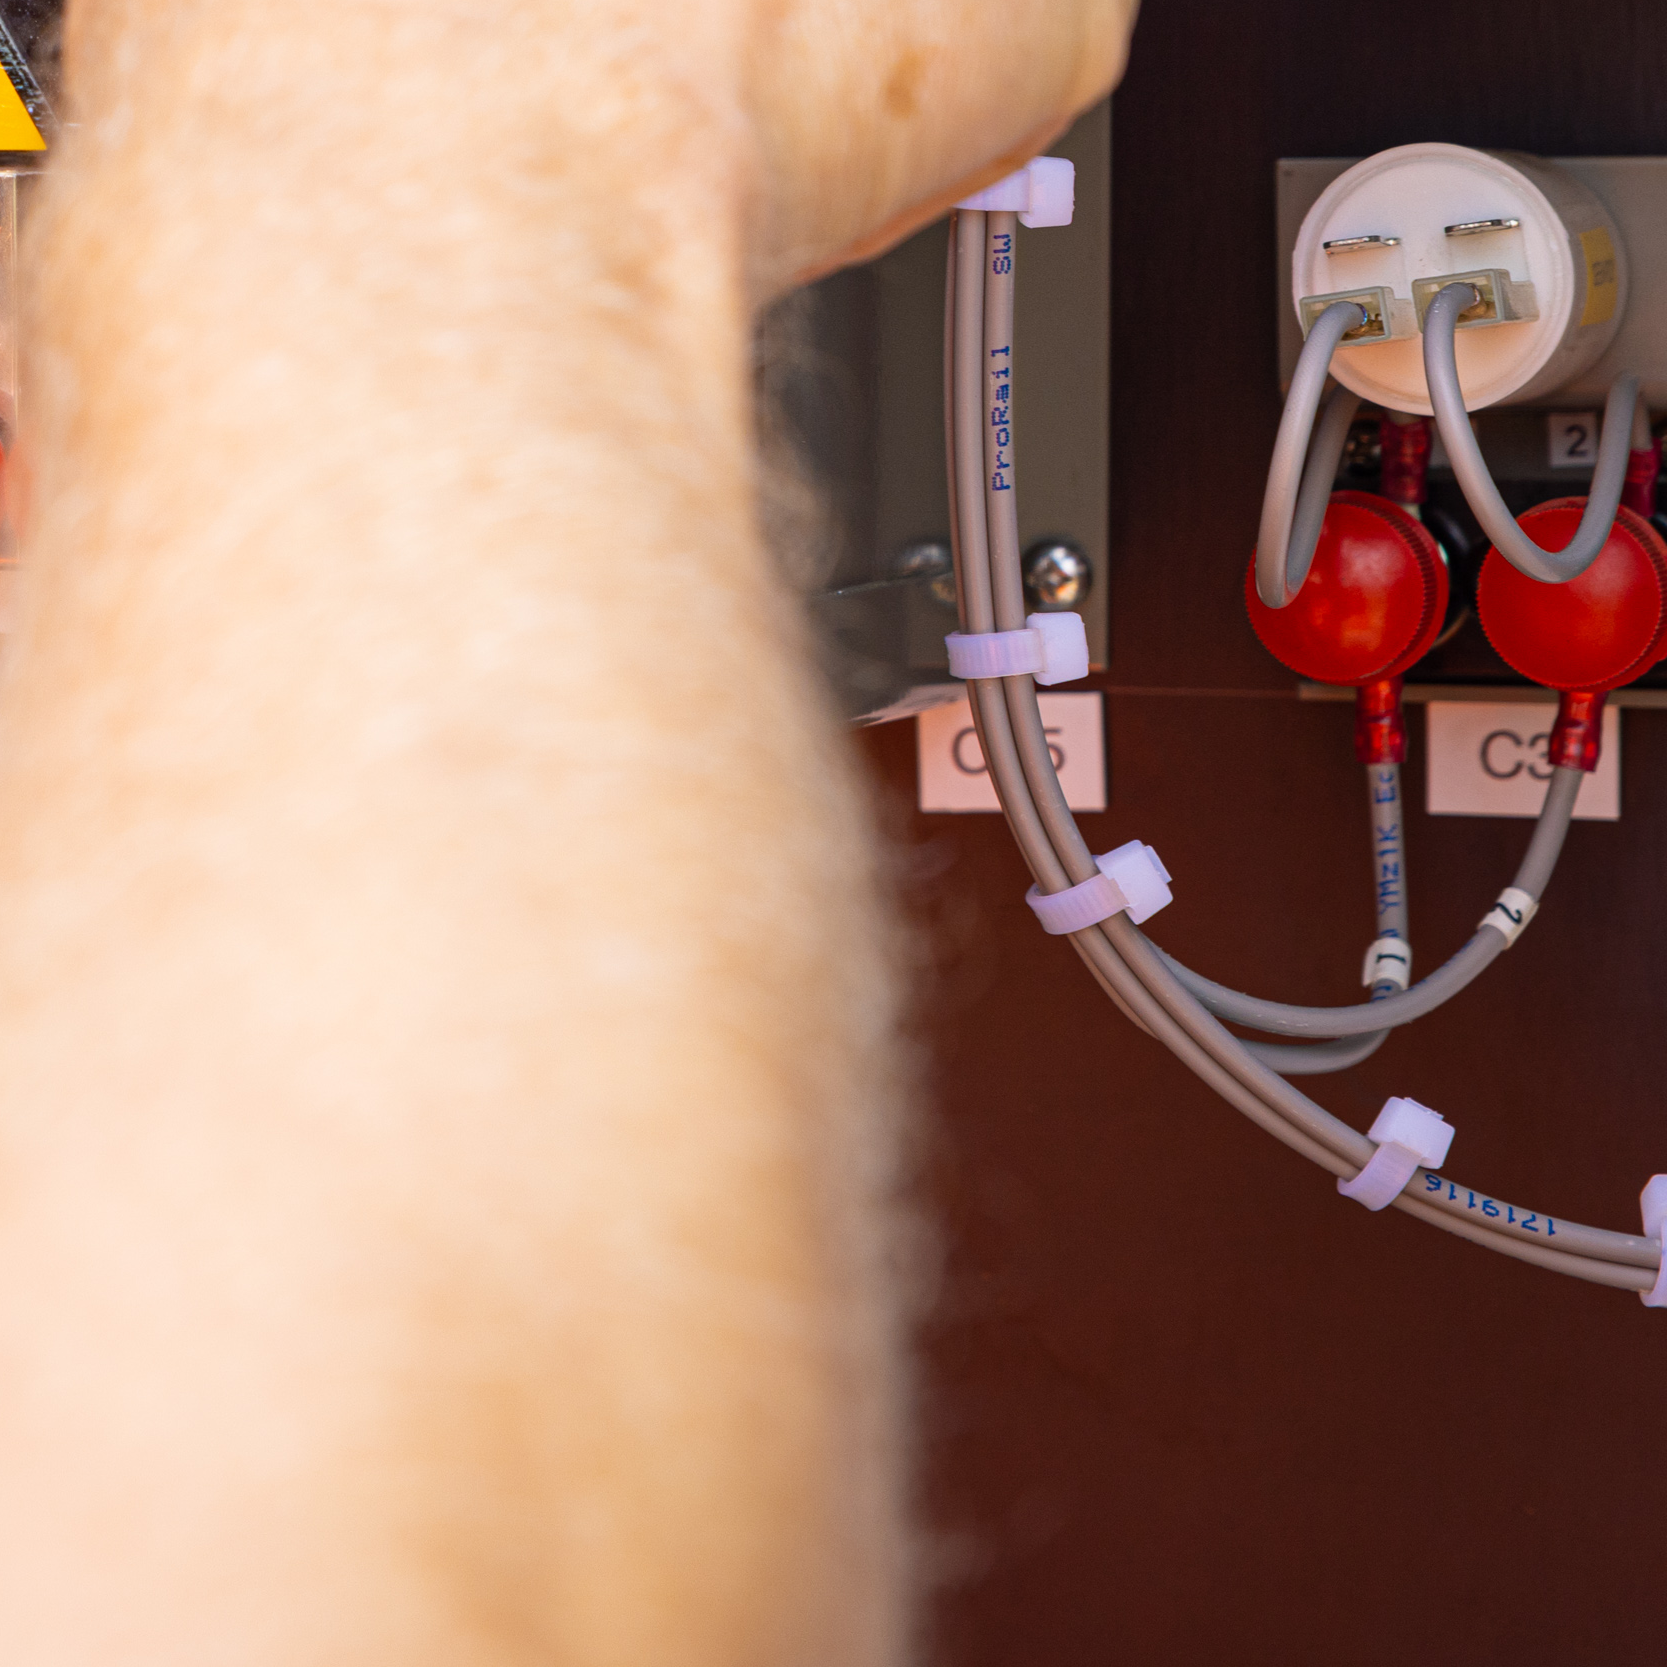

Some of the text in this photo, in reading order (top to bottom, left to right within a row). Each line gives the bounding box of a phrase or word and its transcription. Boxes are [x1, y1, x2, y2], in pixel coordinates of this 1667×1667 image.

[990, 233, 1013, 491] ProRail SW
[1565, 426, 1590, 459] 2
[951, 726, 1065, 775] C5
[1493, 897, 1524, 925] 2
[1374, 951, 1407, 965] 1
[1425, 1174, 1556, 1237] 1719116
